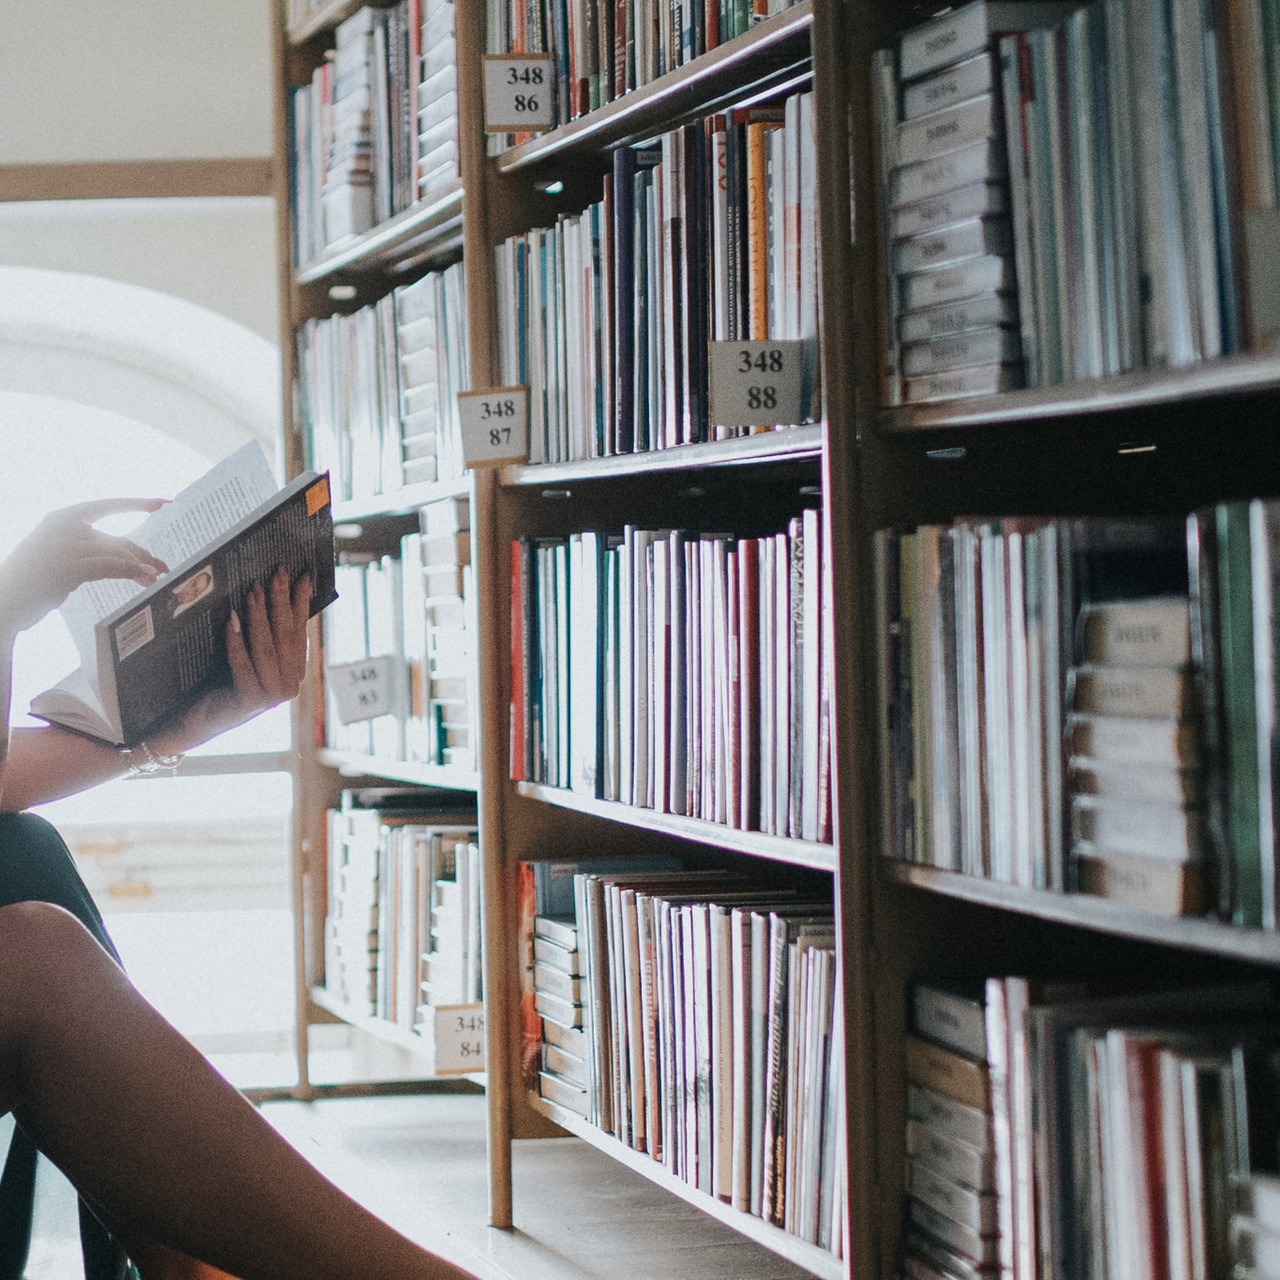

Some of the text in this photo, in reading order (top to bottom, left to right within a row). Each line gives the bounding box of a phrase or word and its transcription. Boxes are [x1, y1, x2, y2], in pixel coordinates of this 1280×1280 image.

[507, 67, 544, 85] 348
[515, 95, 538, 112] 86
[738, 350, 783, 373] 348
[747, 387, 777, 410] 88
[481, 400, 515, 420] 348
[489, 428, 512, 446] 87
[349, 669, 379, 687] 348
[460, 1041, 481, 1057] 84
